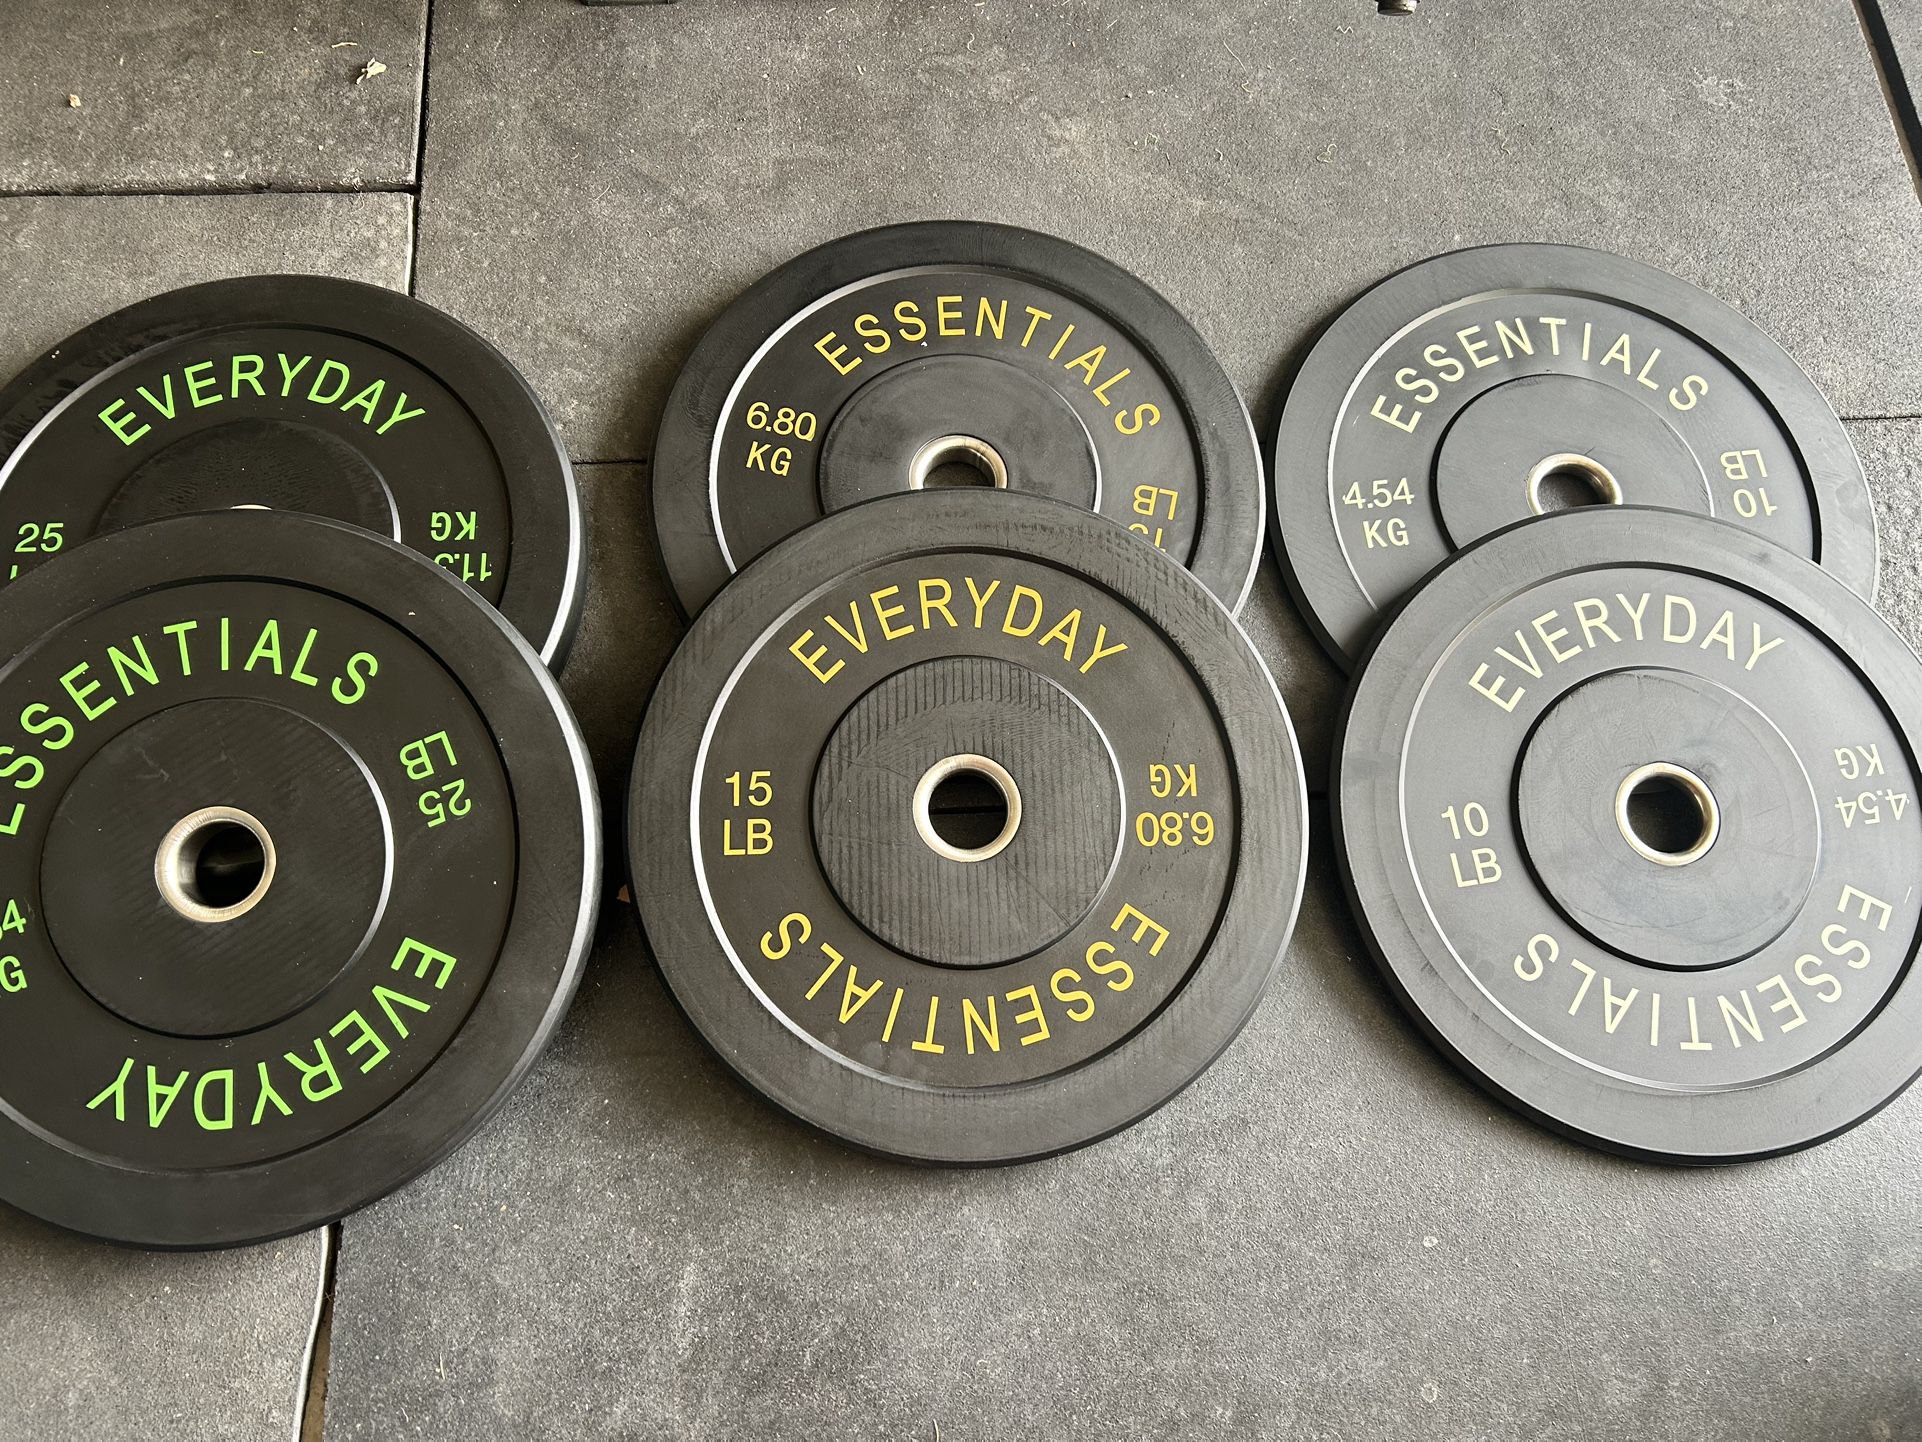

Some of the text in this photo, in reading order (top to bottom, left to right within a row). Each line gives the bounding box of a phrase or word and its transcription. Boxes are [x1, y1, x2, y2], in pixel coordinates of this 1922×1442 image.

[814, 295, 1161, 435] ESSENTIALS
[1370, 316, 1709, 433] ESSENTIALS
[98, 353, 426, 446] EVERYDAY
[746, 401, 817, 442] 6.80
[745, 440, 793, 477] KG
[1720, 448, 1768, 480] LB
[1133, 484, 1179, 520] LB
[1342, 477, 1415, 509] 4.54
[1733, 487, 1778, 518] 10
[14, 522, 64, 553] 25
[430, 511, 477, 541] KG
[1362, 517, 1410, 549] KG
[788, 576, 1128, 685] EVERYDAY
[1467, 592, 1785, 713] EVERYDAY
[399, 730, 458, 780] LB
[1834, 743, 1885, 780] KG
[724, 770, 773, 807] 15
[1149, 763, 1199, 798] KG
[418, 778, 472, 828] 25
[1440, 801, 1490, 840] 10
[1834, 788, 1910, 829] 4.54
[722, 818, 774, 856] LB
[1135, 810, 1215, 848] 6.80
[1449, 847, 1503, 888] LB
[759, 902, 1170, 1056] ESSENTIALS
[1513, 884, 1894, 1051] ESSENTIALS
[85, 936, 458, 1131] EVERYDAY
